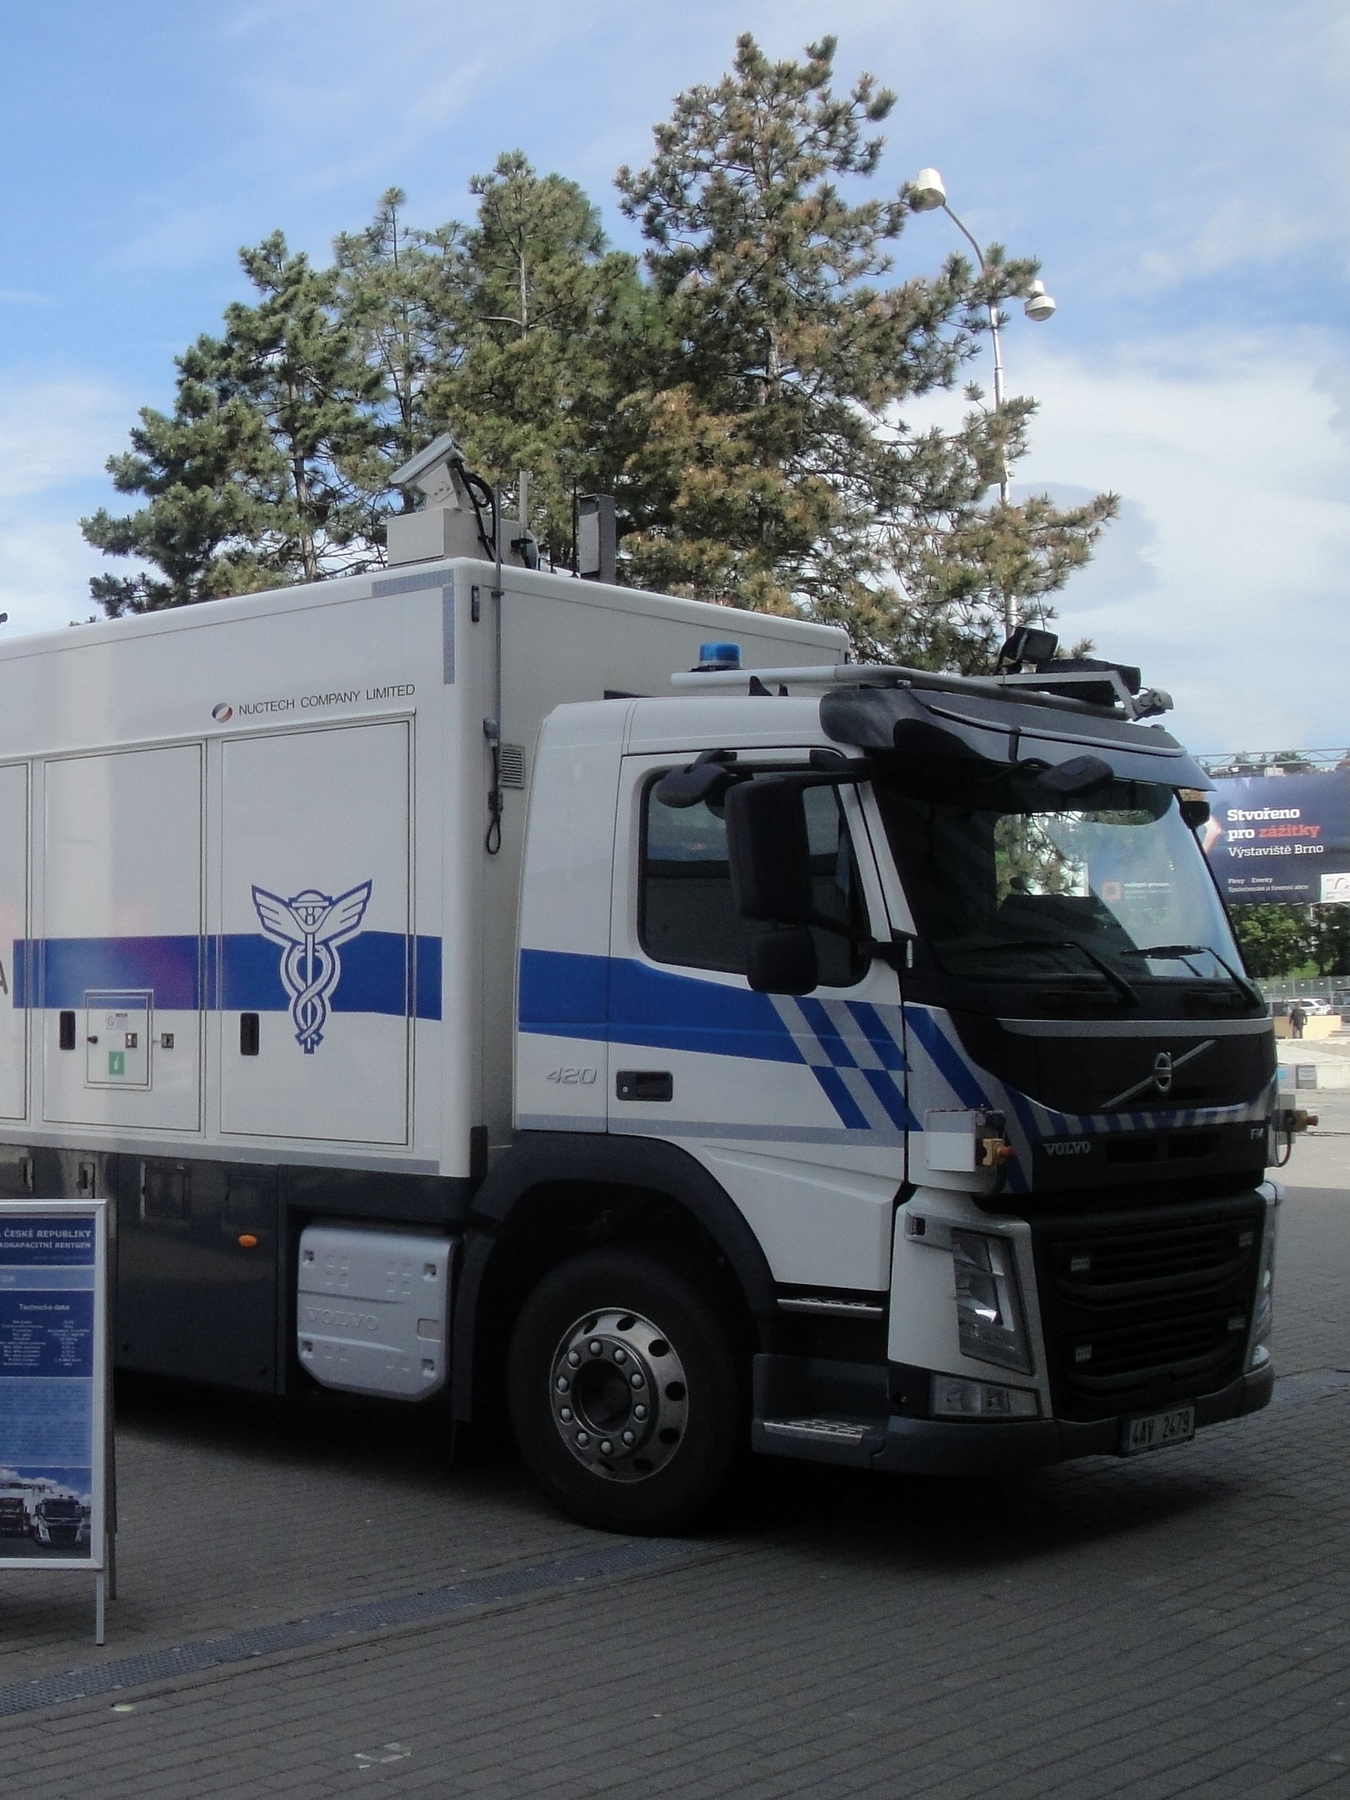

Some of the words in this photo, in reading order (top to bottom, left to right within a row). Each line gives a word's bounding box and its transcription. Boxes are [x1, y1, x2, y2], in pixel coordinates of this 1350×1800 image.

[238, 699, 295, 715] NUCTECH
[301, 690, 361, 708] COMPANY
[366, 683, 415, 700] LIMITED
[1227, 807, 1300, 822] Stvořeno
[1227, 828, 1255, 842] pro
[1258, 824, 1321, 838] zážitky
[1228, 845, 1292, 858] Výstaviště
[1294, 844, 1324, 855] Brno
[546, 1067, 597, 1084] 420
[1043, 1140, 1091, 1156] VOLVO
[4, 1227, 33, 1238] ČESKÉ
[37, 1229, 91, 1238] REPUBLIKY
[54, 1303, 70, 1311] data
[304, 1306, 379, 1331] VOLVO
